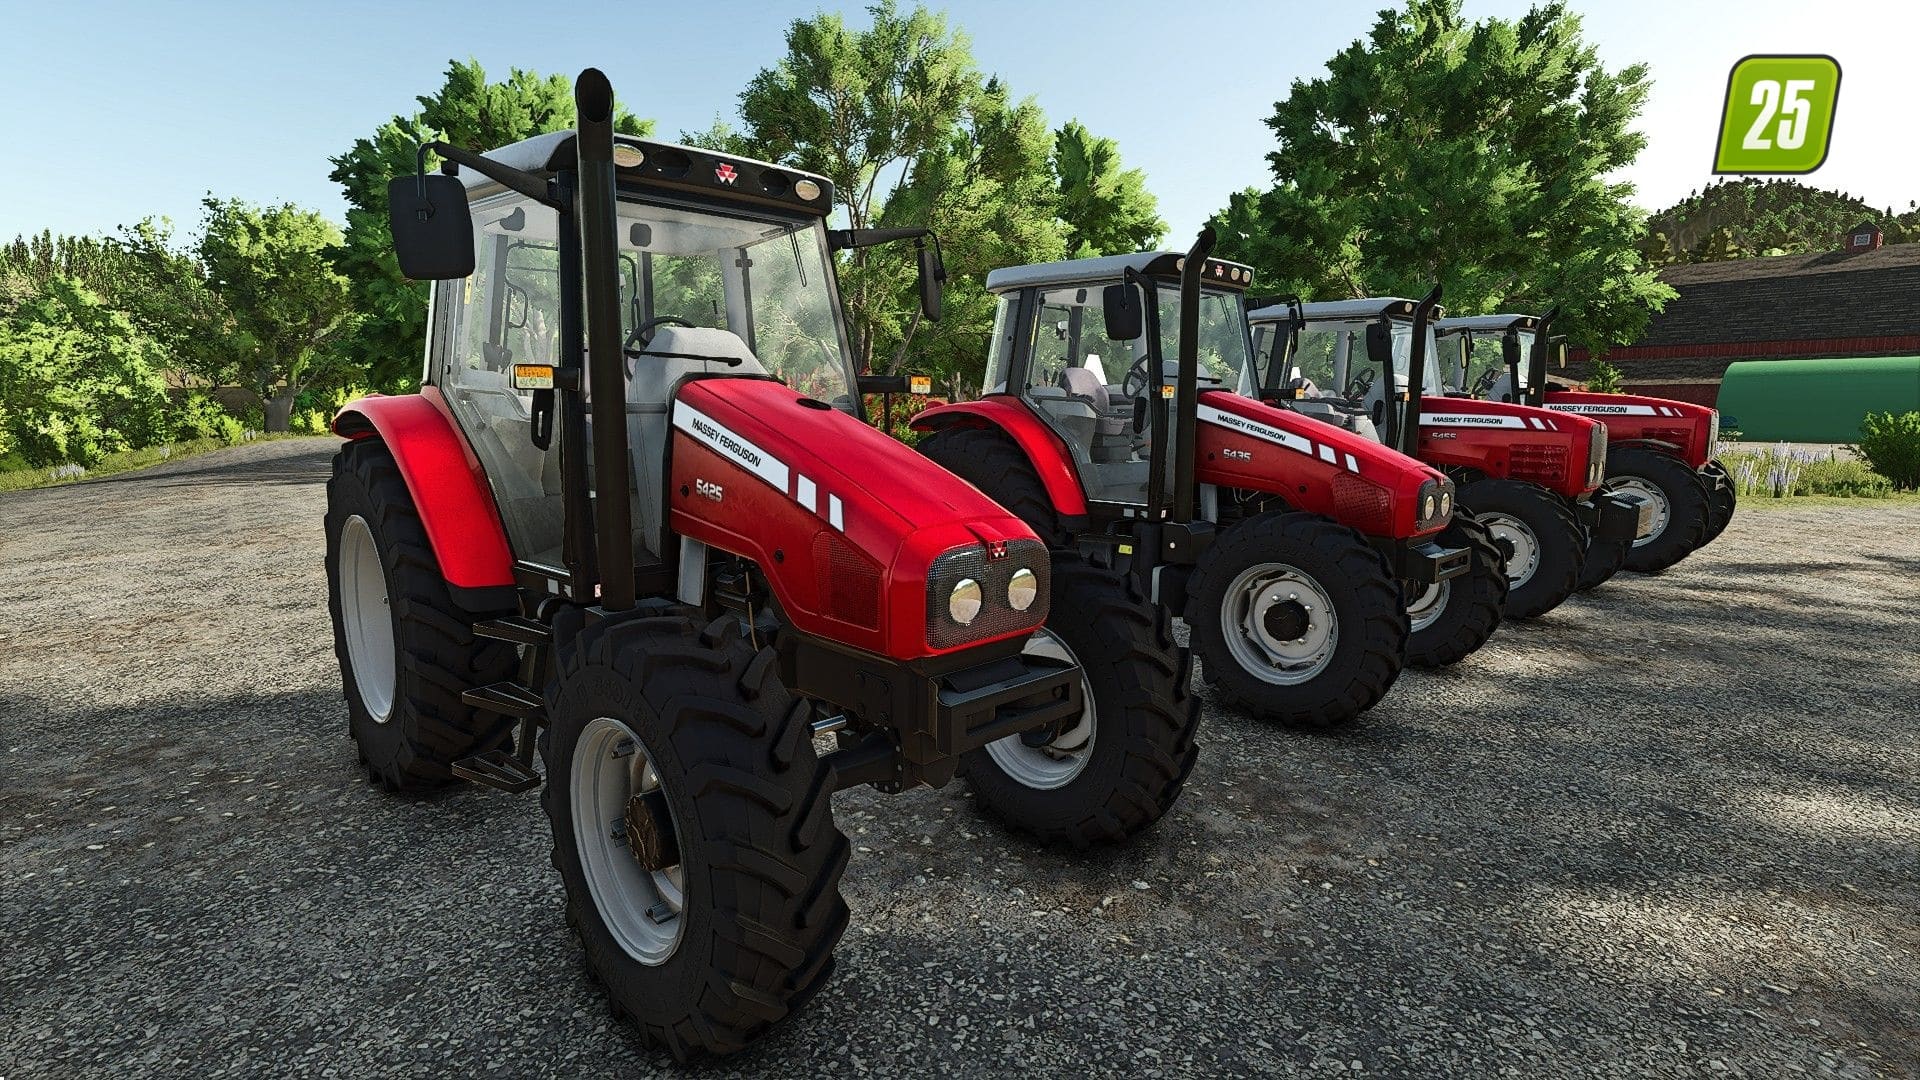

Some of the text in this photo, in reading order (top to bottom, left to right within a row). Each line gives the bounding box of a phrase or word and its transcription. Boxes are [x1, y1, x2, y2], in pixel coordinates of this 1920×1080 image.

[1583, 405, 1627, 413] FERGUSON
[1217, 414, 1286, 441] MASSEY FERGUSON
[1463, 417, 1503, 425] FERGUSON
[692, 418, 761, 467] MASSEY FERGUSON
[1223, 448, 1251, 461] 5435
[696, 479, 723, 502] 5425
